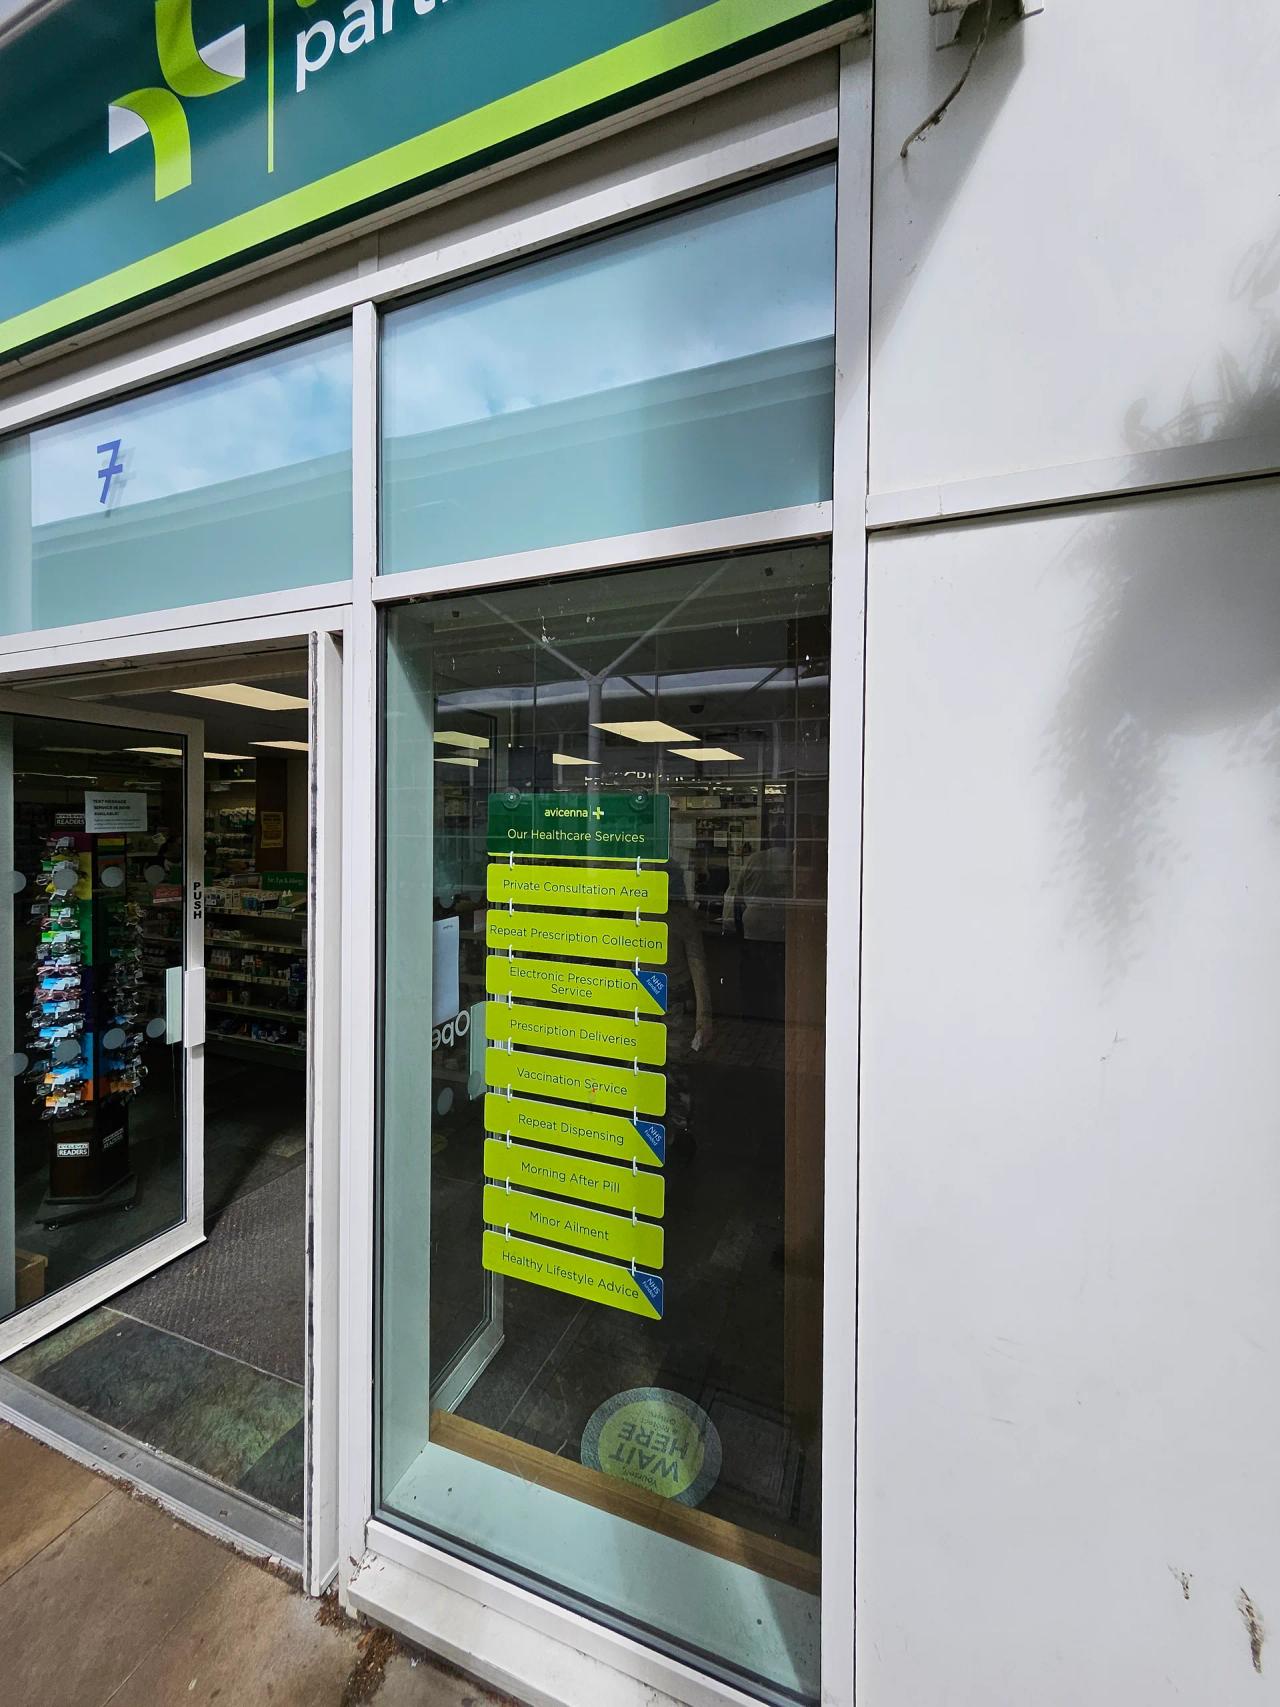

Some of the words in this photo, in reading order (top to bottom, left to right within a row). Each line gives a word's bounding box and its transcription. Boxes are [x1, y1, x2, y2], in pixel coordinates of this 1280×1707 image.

[97, 439, 123, 504] 7
[544, 808, 589, 818] avicenna
[507, 828, 528, 840] Our
[531, 829, 592, 842] Healthcare
[595, 831, 645, 844] Services
[194, 882, 202, 920] PUSH
[503, 879, 540, 892] Private
[544, 881, 616, 896] Consultation
[620, 886, 649, 898] Area
[490, 924, 527, 939] Repeat
[530, 928, 598, 945] Prescription
[602, 934, 663, 950] Collection
[510, 966, 564, 982] Electronic
[568, 974, 638, 991] Prescription
[551, 984, 593, 998] Service
[650, 974, 664, 991] NHS
[510, 1020, 576, 1039] Prescription
[580, 1028, 638, 1047] Deliveries
[516, 1066, 581, 1087] Vaccination
[584, 1078, 628, 1096] Service
[518, 1114, 557, 1132] Repeat
[560, 1122, 624, 1146] Dispensing
[648, 1126, 662, 1142] NHS
[521, 1162, 566, 1183] Morning
[570, 1173, 599, 1188] After
[602, 1180, 620, 1194] Pill
[530, 1211, 561, 1228] Minor
[564, 1220, 609, 1241] Ailment
[502, 1250, 544, 1275] Healthy
[546, 1261, 594, 1286] Lifestyle
[597, 1278, 639, 1299] Advice
[646, 1278, 660, 1295] NHS
[618, 1422, 690, 1461] HERE
[608, 1442, 679, 1483] WAIT
